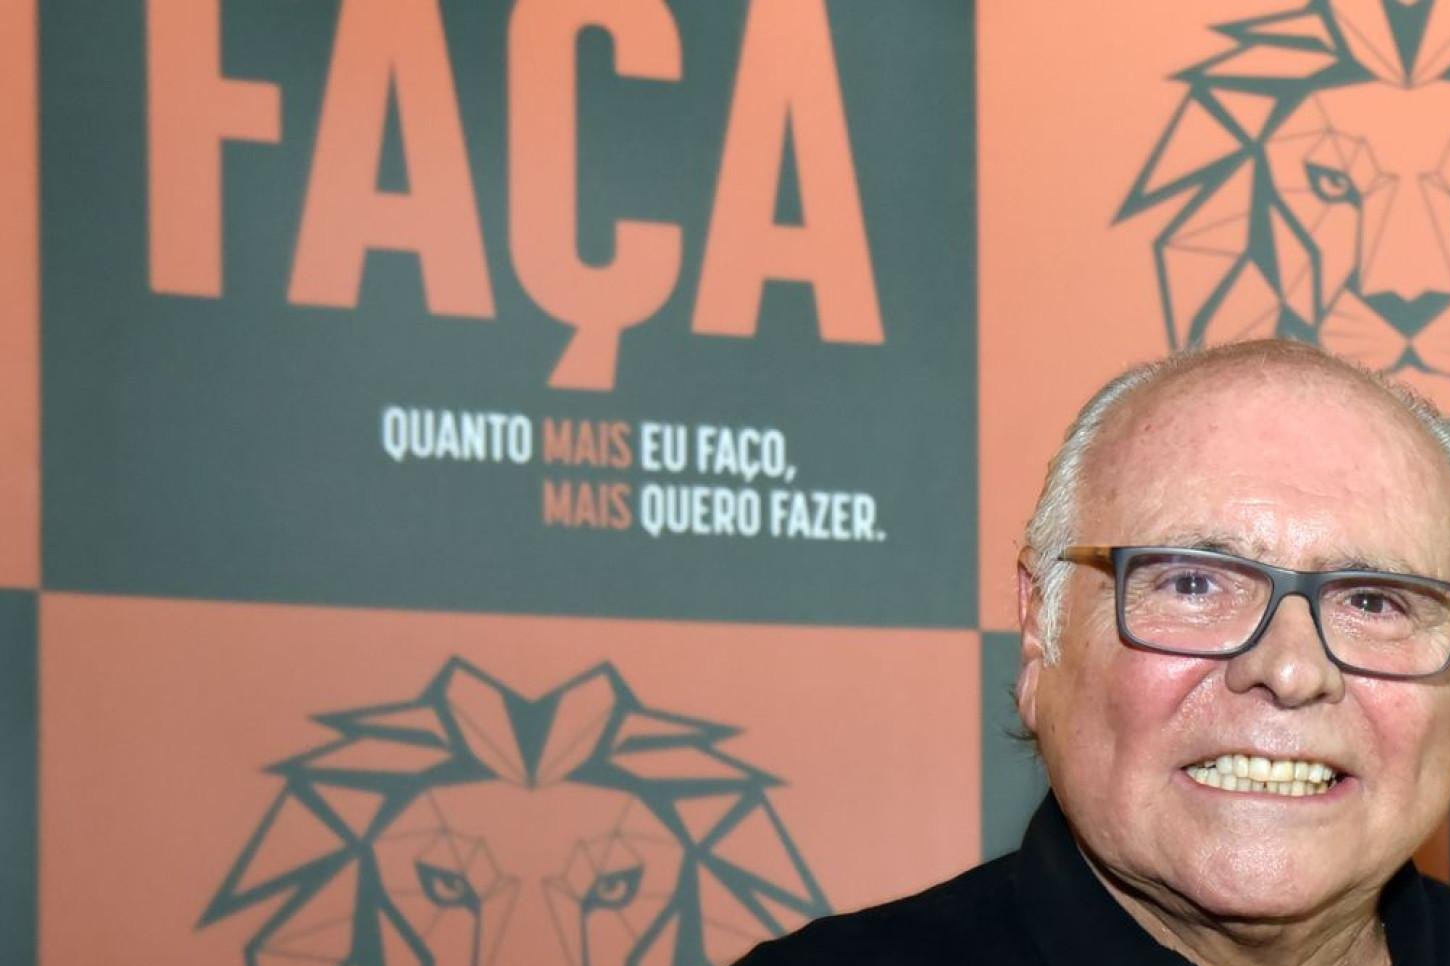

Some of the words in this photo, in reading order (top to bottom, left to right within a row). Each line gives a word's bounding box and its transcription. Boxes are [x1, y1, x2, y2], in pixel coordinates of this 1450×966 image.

[147, 0, 885, 390] FAÇA
[382, 407, 532, 463] QUANTO
[542, 418, 633, 468] MAIS
[641, 423, 687, 472] EU
[696, 426, 796, 482] FAÇO,
[542, 481, 632, 530] MAIS
[640, 485, 761, 538] QUERO
[770, 490, 886, 542] FAZER.
